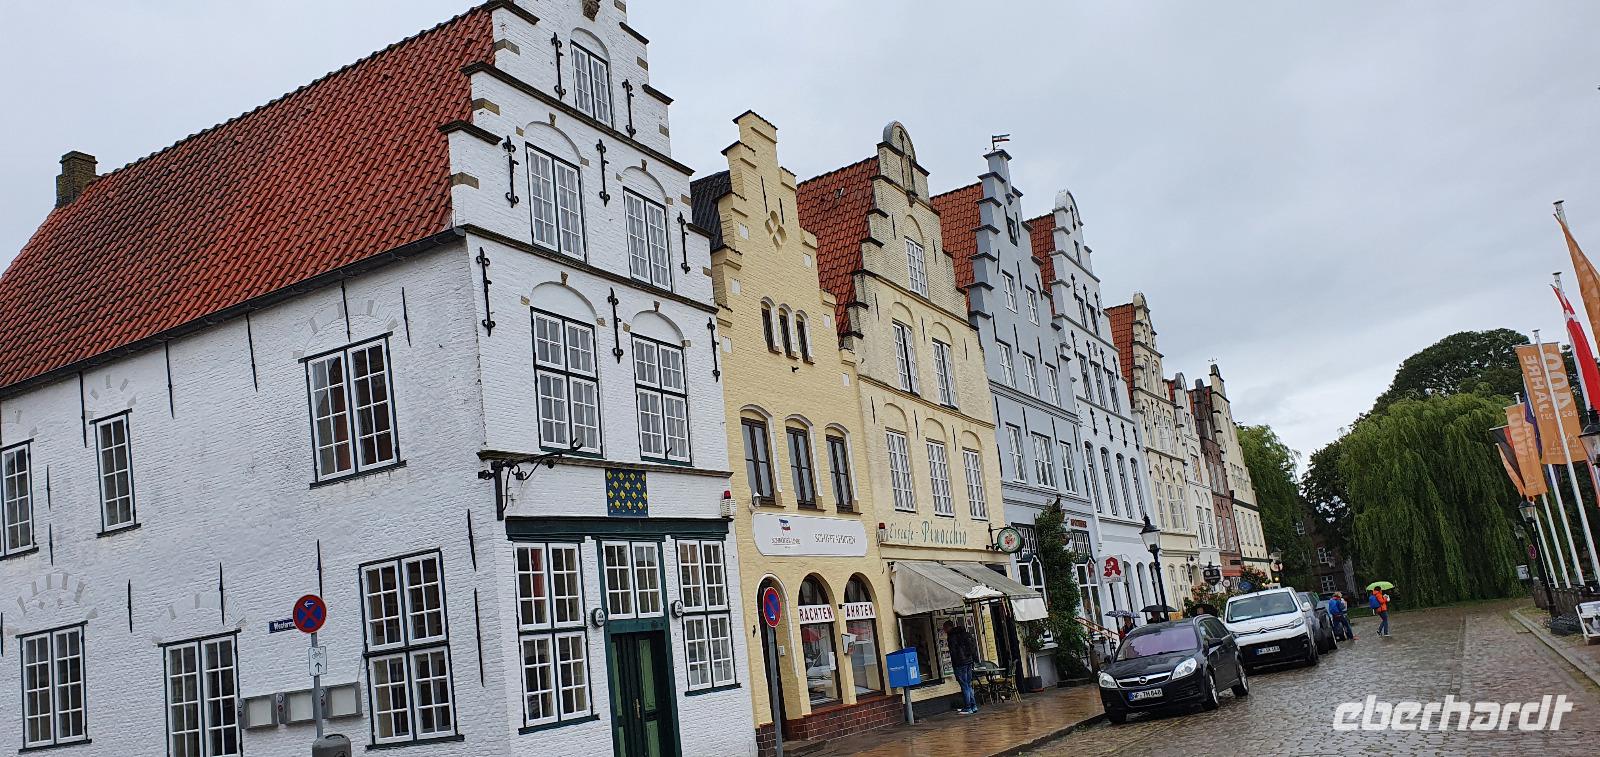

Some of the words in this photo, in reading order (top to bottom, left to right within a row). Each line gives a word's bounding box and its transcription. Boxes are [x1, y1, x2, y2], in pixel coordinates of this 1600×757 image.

[922, 519, 967, 546] Pinocchio
[799, 606, 833, 622] RACHTEN
[846, 604, 874, 618] AHRTEN
